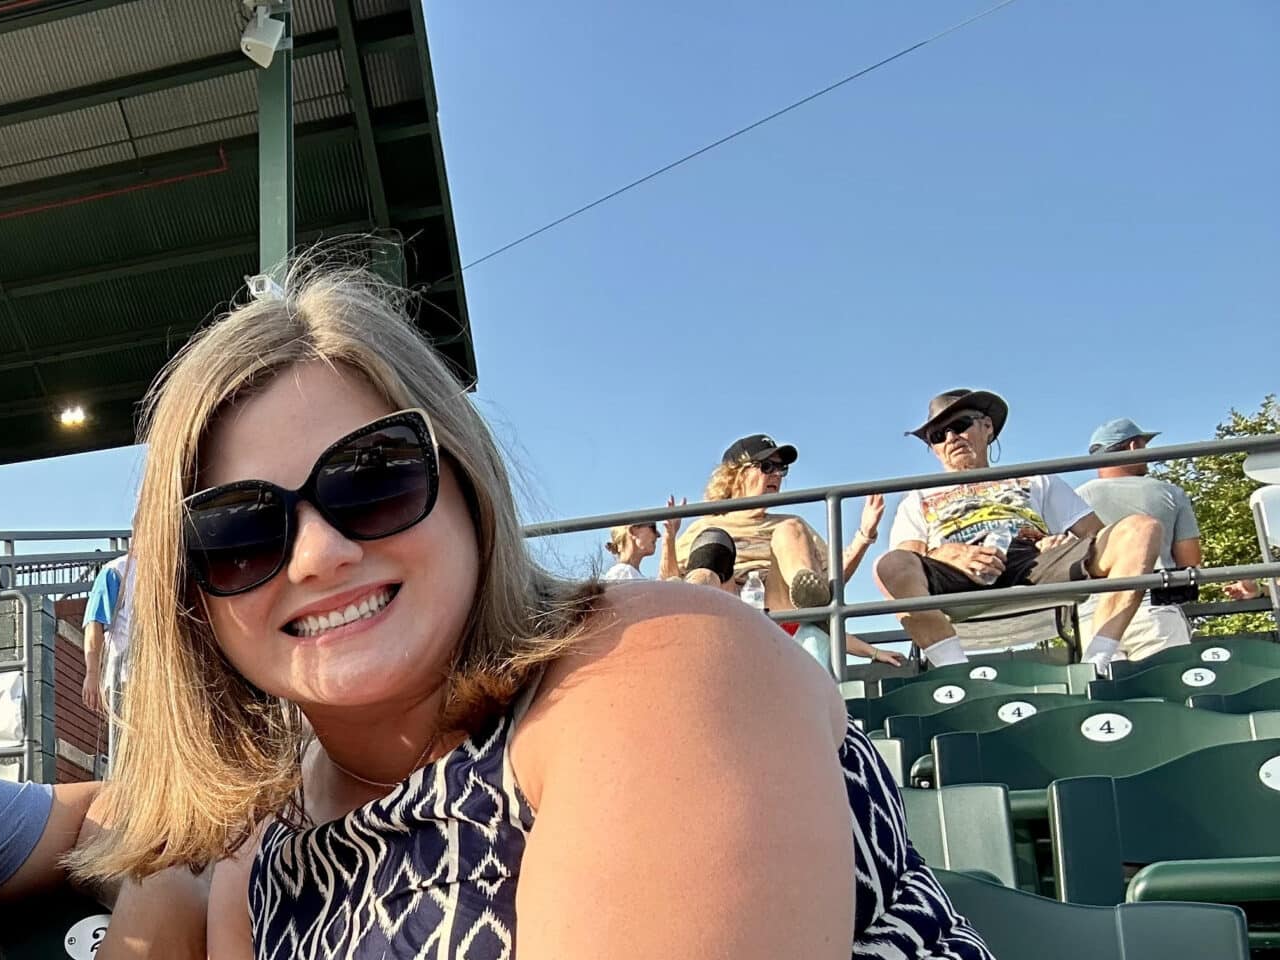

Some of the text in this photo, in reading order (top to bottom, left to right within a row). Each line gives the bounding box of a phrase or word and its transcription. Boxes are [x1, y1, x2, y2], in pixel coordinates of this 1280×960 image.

[1211, 651, 1221, 660] 5
[980, 670, 988, 679] 4
[1194, 672, 1204, 682] 5
[944, 690, 955, 700] 4
[1011, 706, 1023, 718] 4
[1099, 720, 1115, 735] 4
